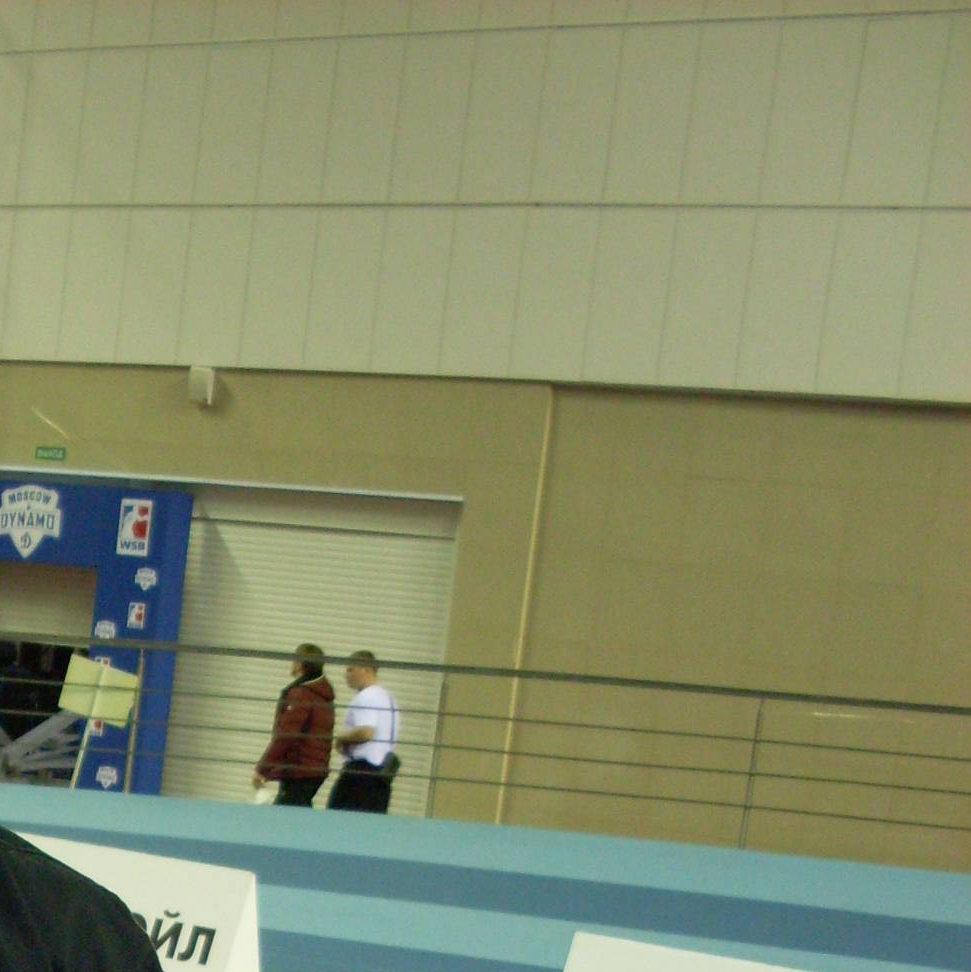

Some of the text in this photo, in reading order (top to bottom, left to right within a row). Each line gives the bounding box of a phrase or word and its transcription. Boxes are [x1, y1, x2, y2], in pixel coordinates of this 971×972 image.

[8, 489, 52, 505] MOSCOW
[1, 511, 55, 531] DYNAMO
[120, 540, 145, 550] WSB
[131, 908, 216, 966] ЙЛ
